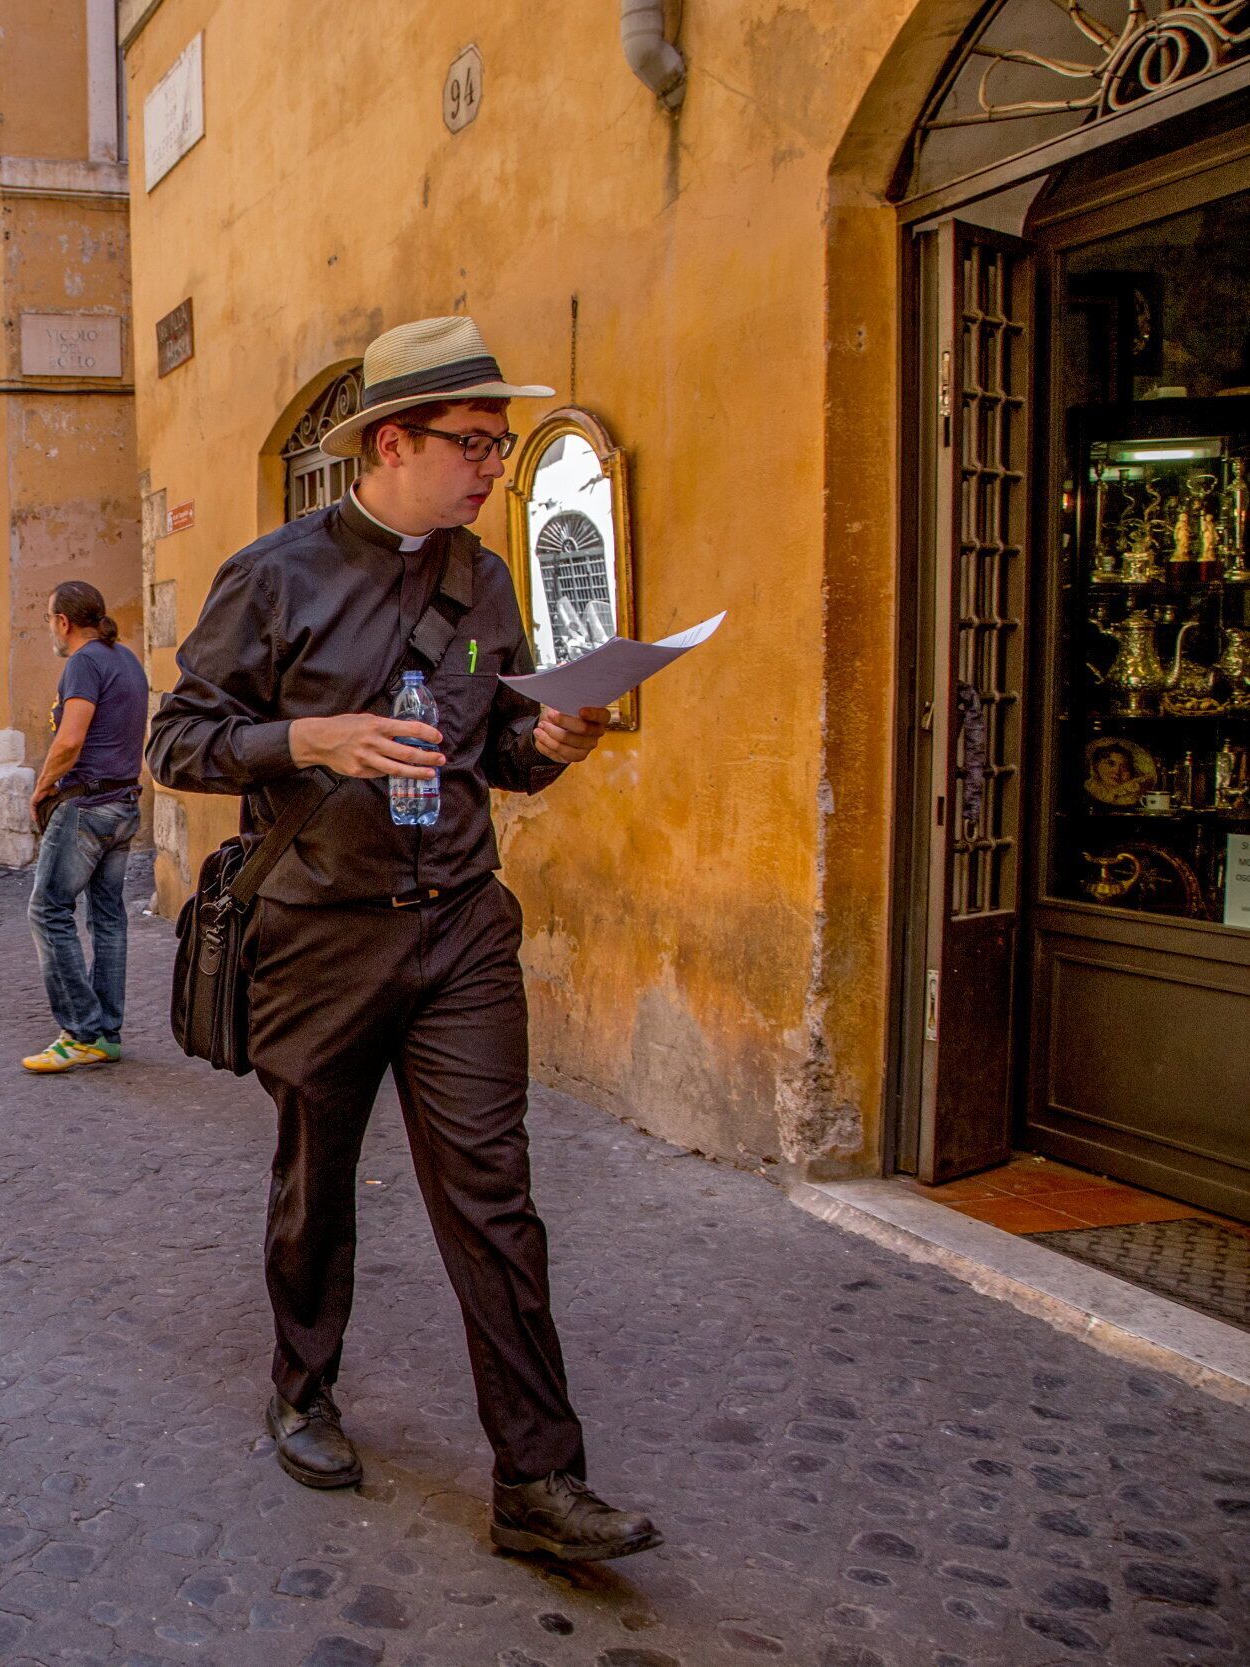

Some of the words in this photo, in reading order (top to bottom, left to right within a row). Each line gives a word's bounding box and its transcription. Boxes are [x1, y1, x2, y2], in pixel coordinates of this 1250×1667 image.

[451, 67, 474, 119] 94
[46, 328, 98, 342] VICOLO
[59, 343, 81, 354] DEL
